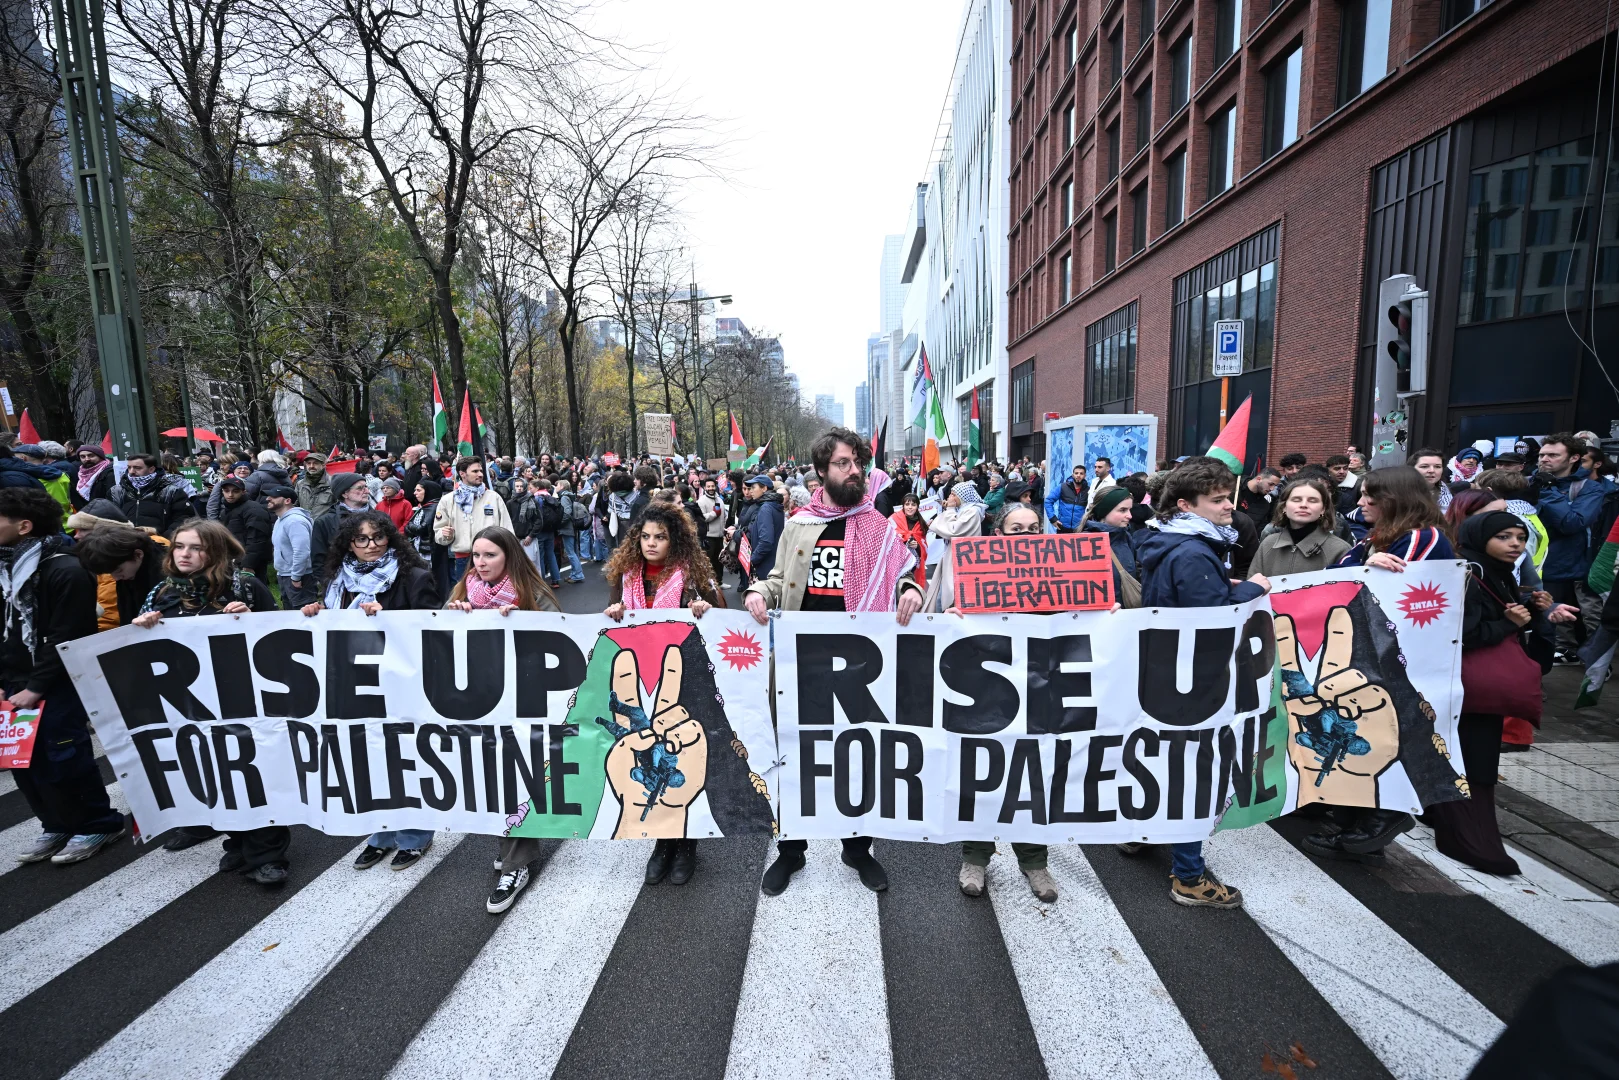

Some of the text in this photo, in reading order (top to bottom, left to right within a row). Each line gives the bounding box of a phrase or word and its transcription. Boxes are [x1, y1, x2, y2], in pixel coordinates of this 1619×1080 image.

[955, 537, 1106, 567] RESISTANCE
[1005, 567, 1064, 579] UNTIL
[959, 577, 1109, 609] LIBERATION
[1409, 599, 1439, 611] INTAL
[727, 646, 757, 655] INTAL
[96, 629, 587, 730] RISE UP
[796, 609, 1276, 735] RISE UP
[131, 720, 582, 817] FOR PALESTINE
[798, 706, 1278, 826] FOR PALESTINE
